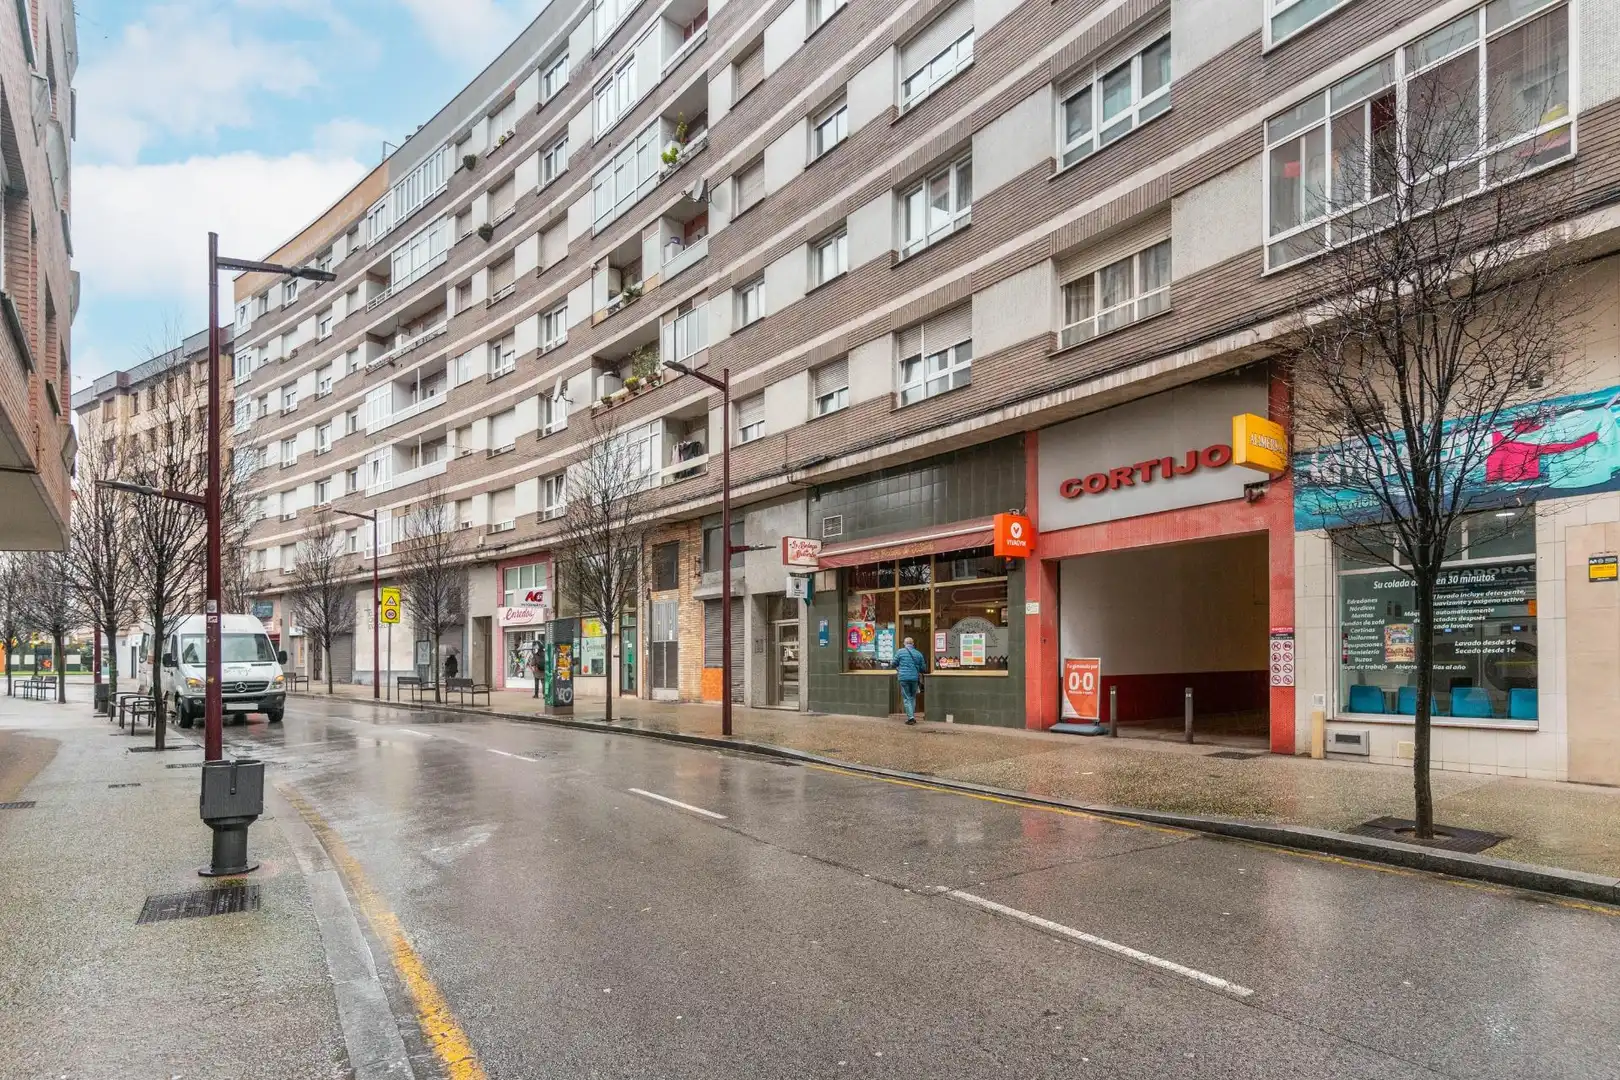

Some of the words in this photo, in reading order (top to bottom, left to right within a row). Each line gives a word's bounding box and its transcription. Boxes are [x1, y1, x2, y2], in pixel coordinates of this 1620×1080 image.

[1059, 444, 1233, 499] CORTIJO
[1373, 581, 1382, 589] Su
[1384, 579, 1409, 588] colada
[1436, 577, 1446, 585] en
[1448, 575, 1459, 584] 30
[1460, 573, 1496, 584] minutos
[1460, 590, 1484, 599] incluye
[1485, 588, 1526, 597] detergente,
[1349, 604, 1376, 612] Nórdicos
[1371, 618, 1385, 626] sofá
[1458, 615, 1486, 623] después
[1364, 663, 1388, 671] trabajo
